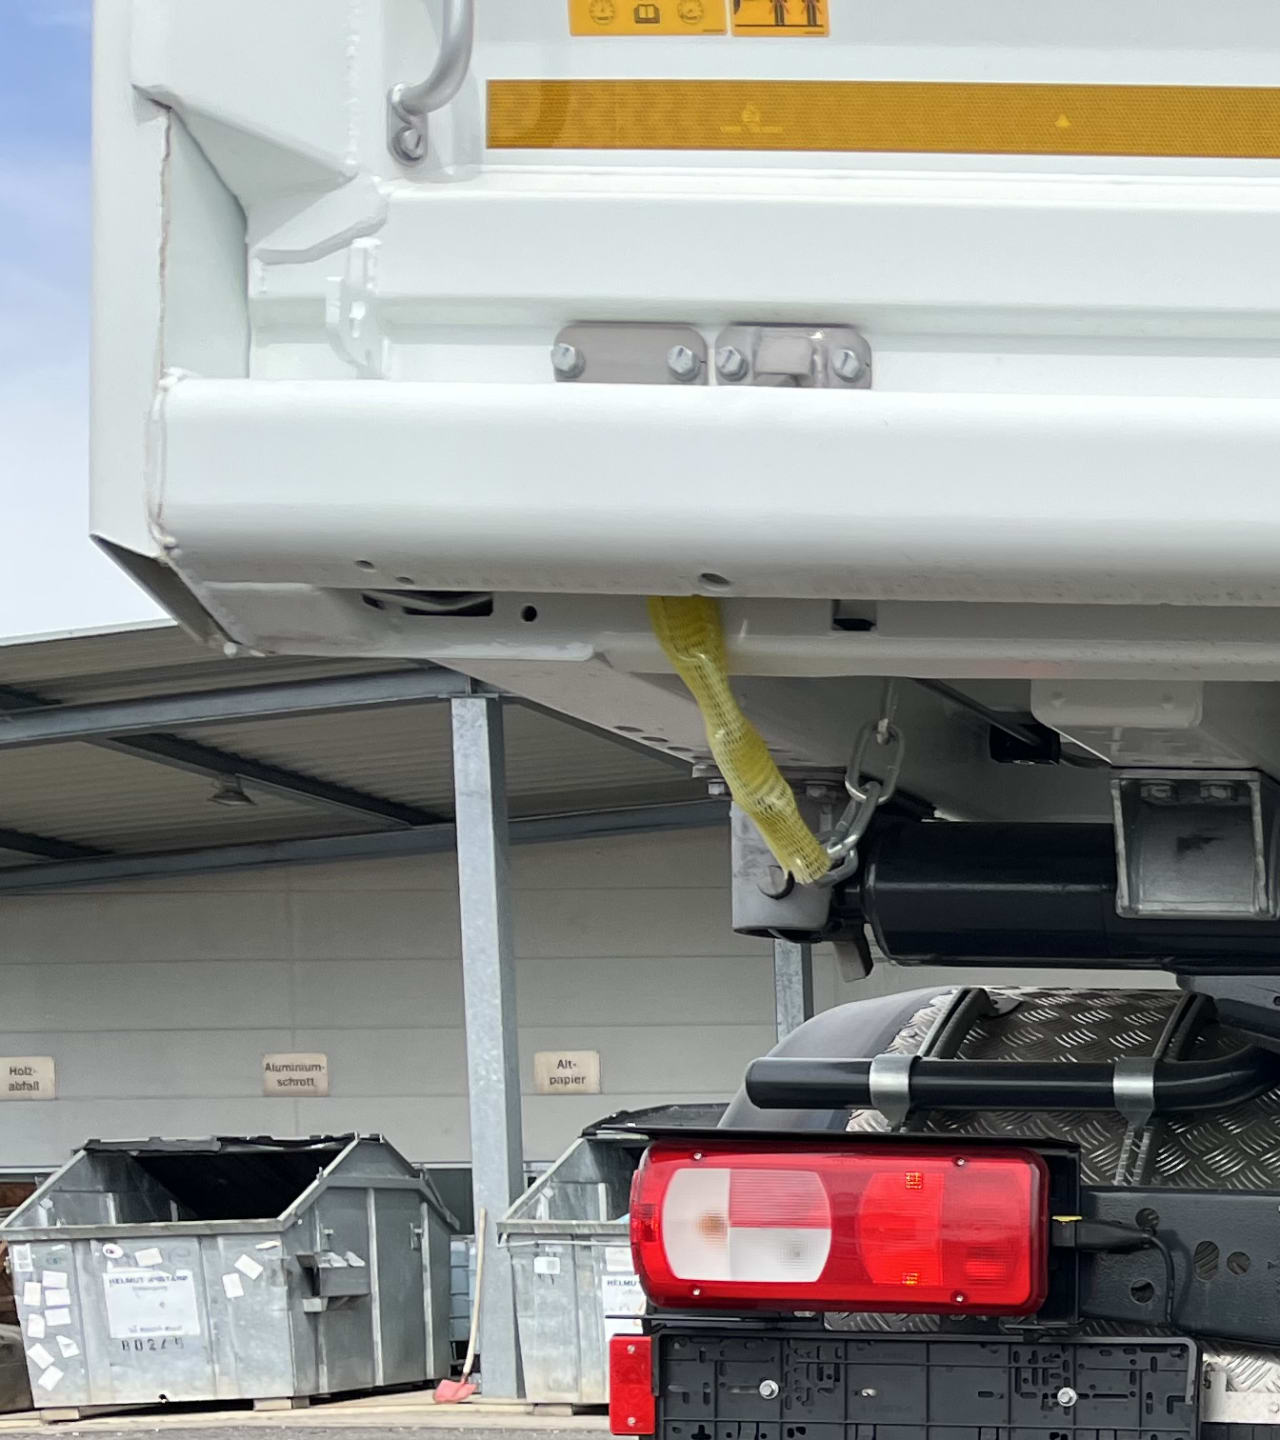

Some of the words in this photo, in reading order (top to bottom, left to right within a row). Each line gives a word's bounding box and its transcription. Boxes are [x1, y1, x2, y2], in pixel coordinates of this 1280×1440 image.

[8, 1080, 40, 1092] abfall
[549, 1075, 586, 1087] papier
[607, 1279, 642, 1287] HELMU
